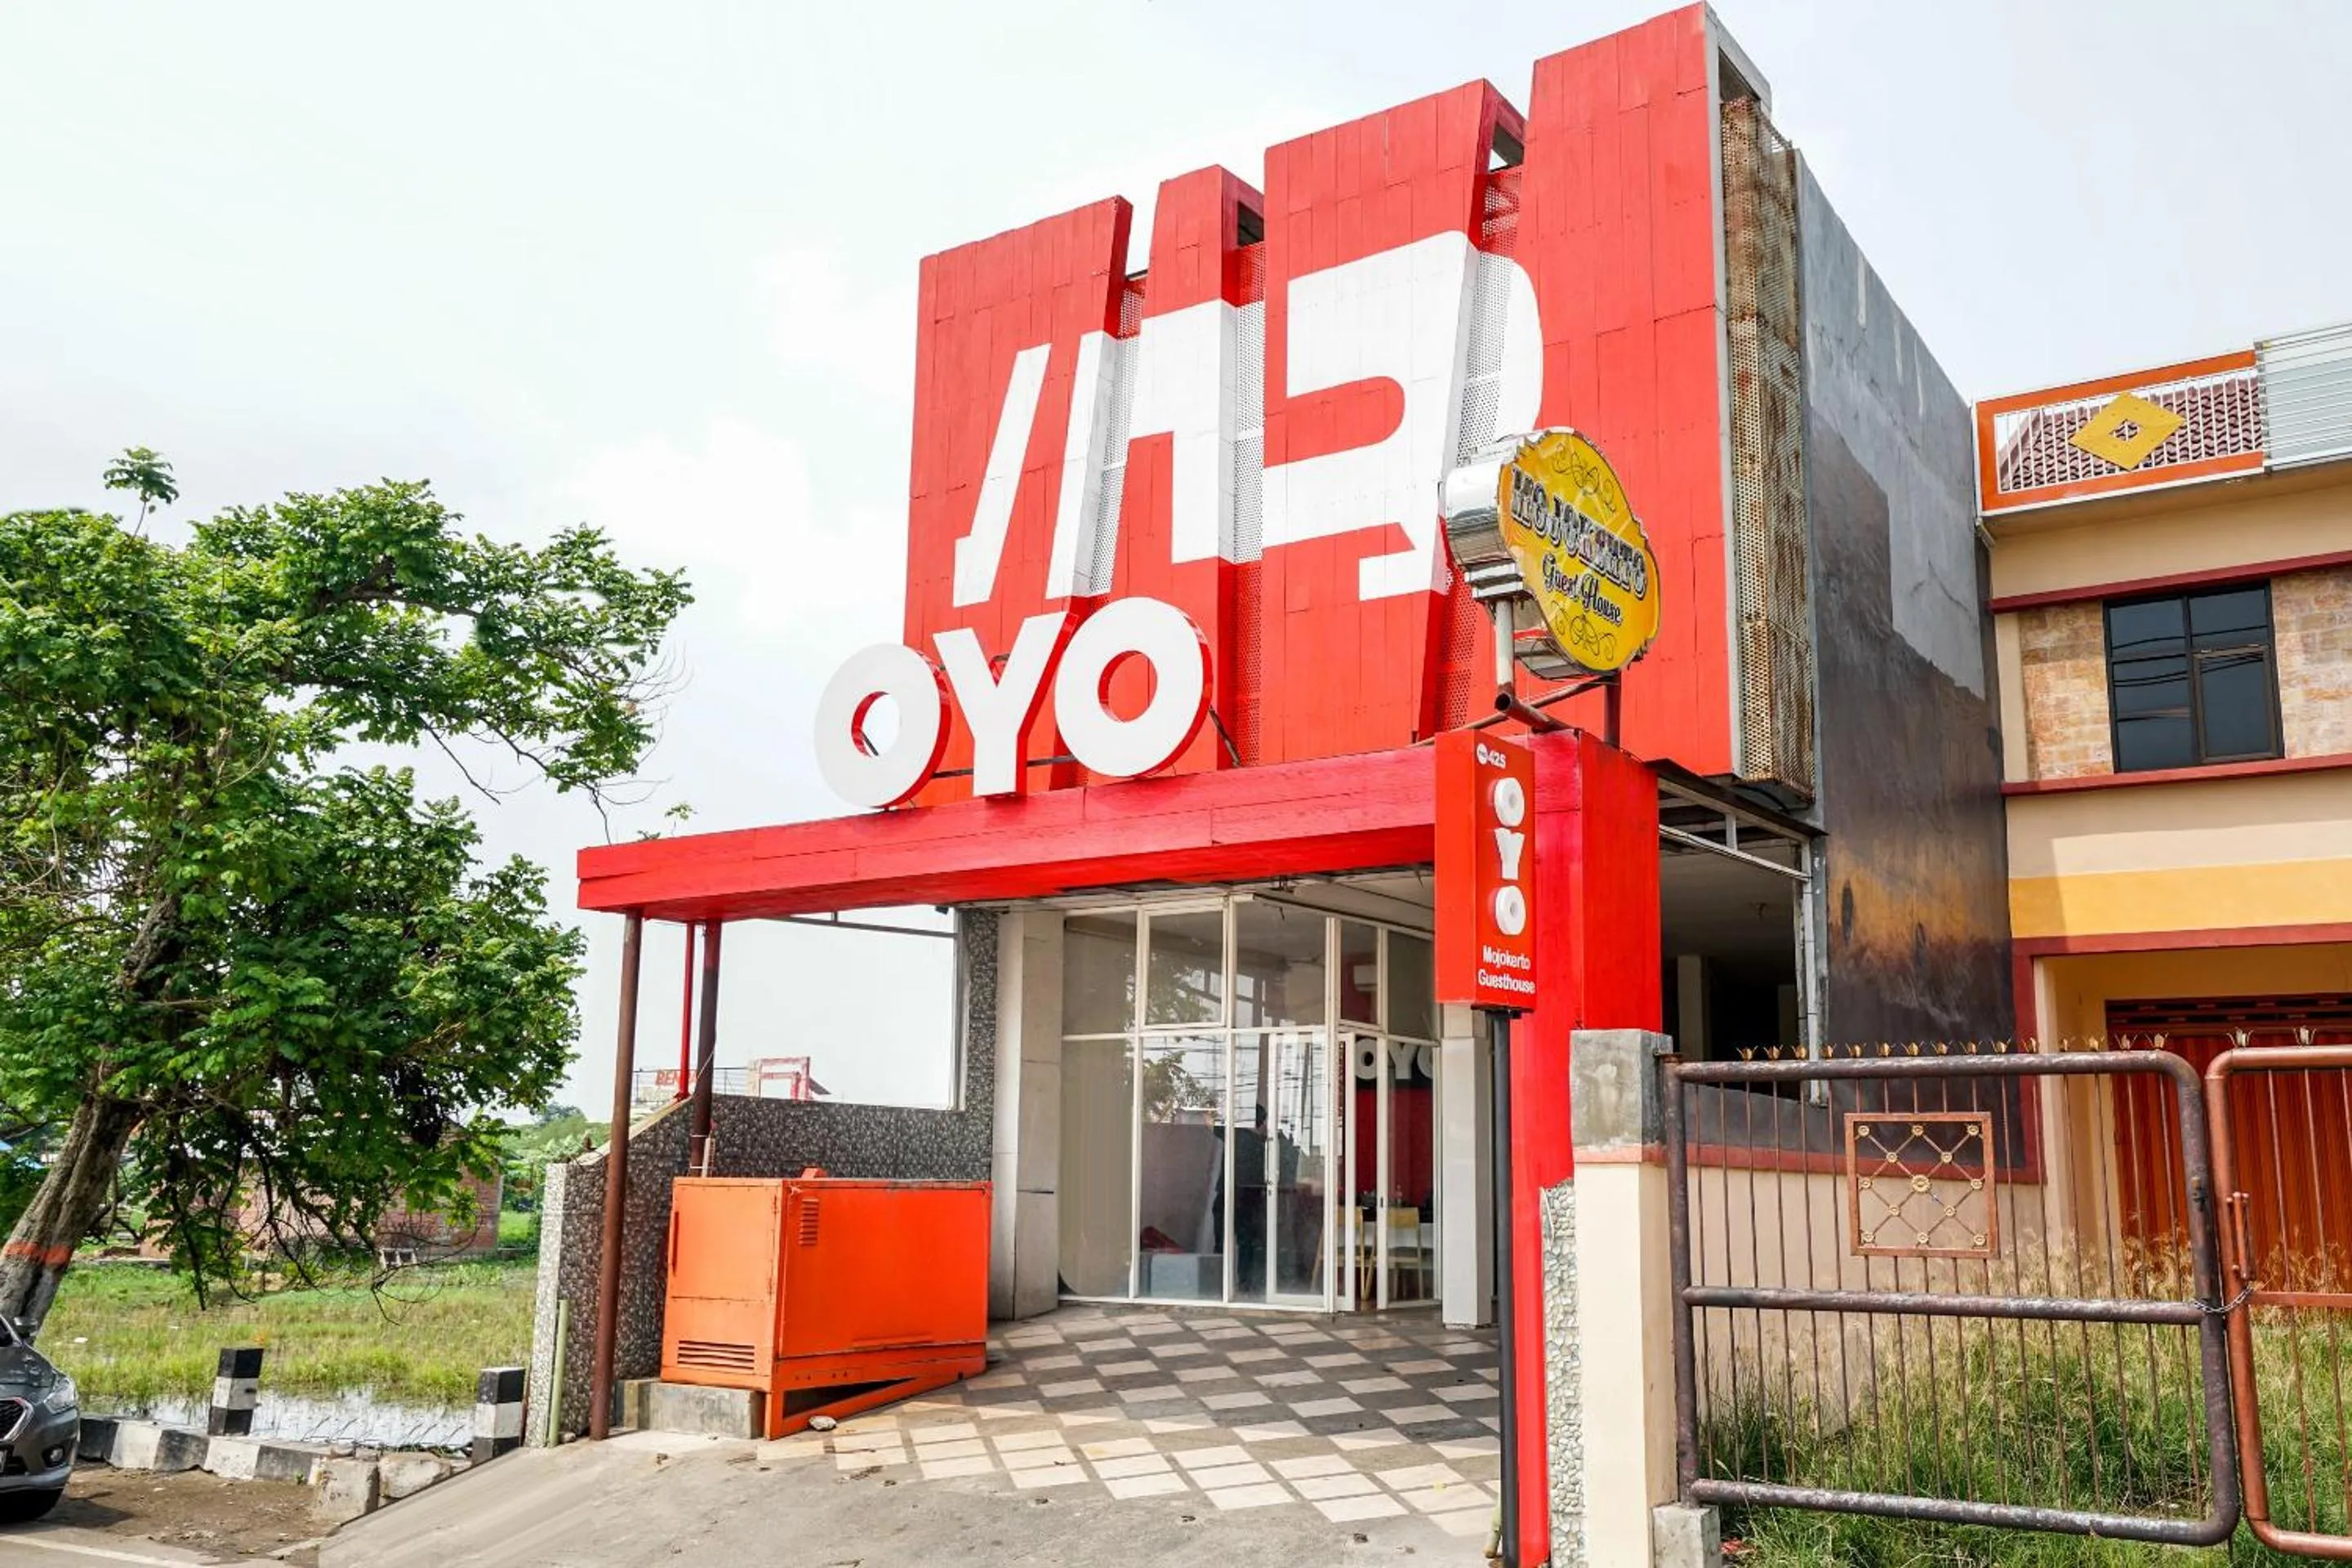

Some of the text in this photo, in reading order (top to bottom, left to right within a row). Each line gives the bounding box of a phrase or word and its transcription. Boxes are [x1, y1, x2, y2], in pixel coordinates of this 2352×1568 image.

[1543, 554, 1623, 626] Guest House
[814, 597, 1212, 809] OYO
[1494, 777, 1526, 936] OYO
[1477, 969, 1536, 994] Guesthouse
[1482, 945, 1531, 970] Mojokerto
